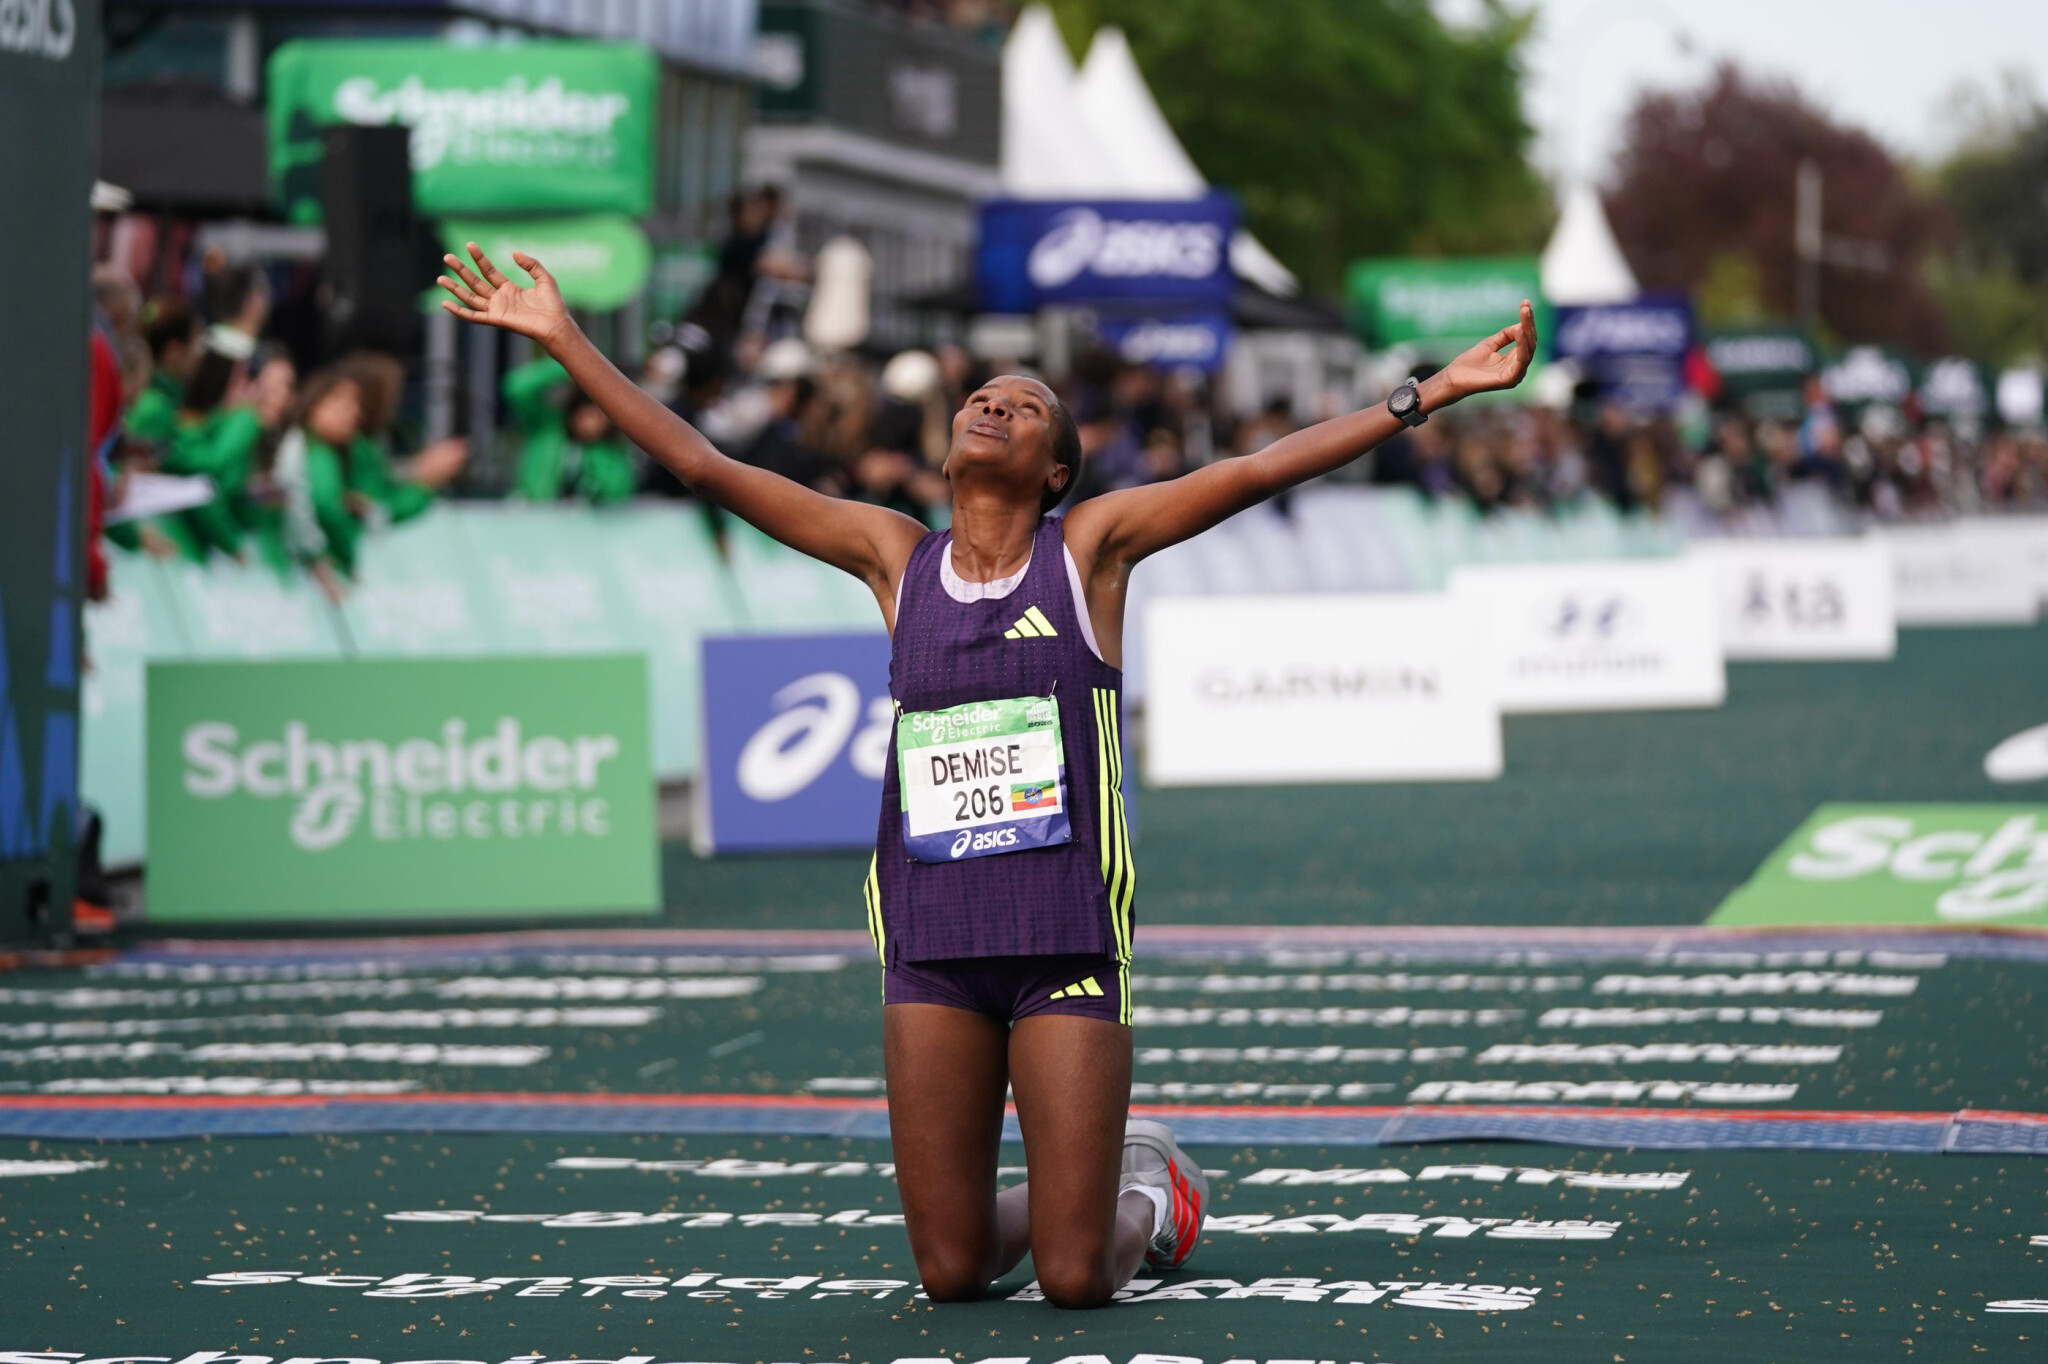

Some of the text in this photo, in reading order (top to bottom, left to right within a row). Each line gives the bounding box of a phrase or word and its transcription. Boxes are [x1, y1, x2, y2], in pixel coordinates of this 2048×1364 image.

[912, 704, 1003, 733] Schneider
[948, 722, 1002, 740] Electric
[182, 718, 620, 797] Schneider
[931, 744, 1023, 786] DEMISE
[371, 795, 610, 841] Electric
[954, 785, 1004, 822] 206
[972, 828, 1019, 851] asics
[192, 1271, 923, 1290] Schneide
